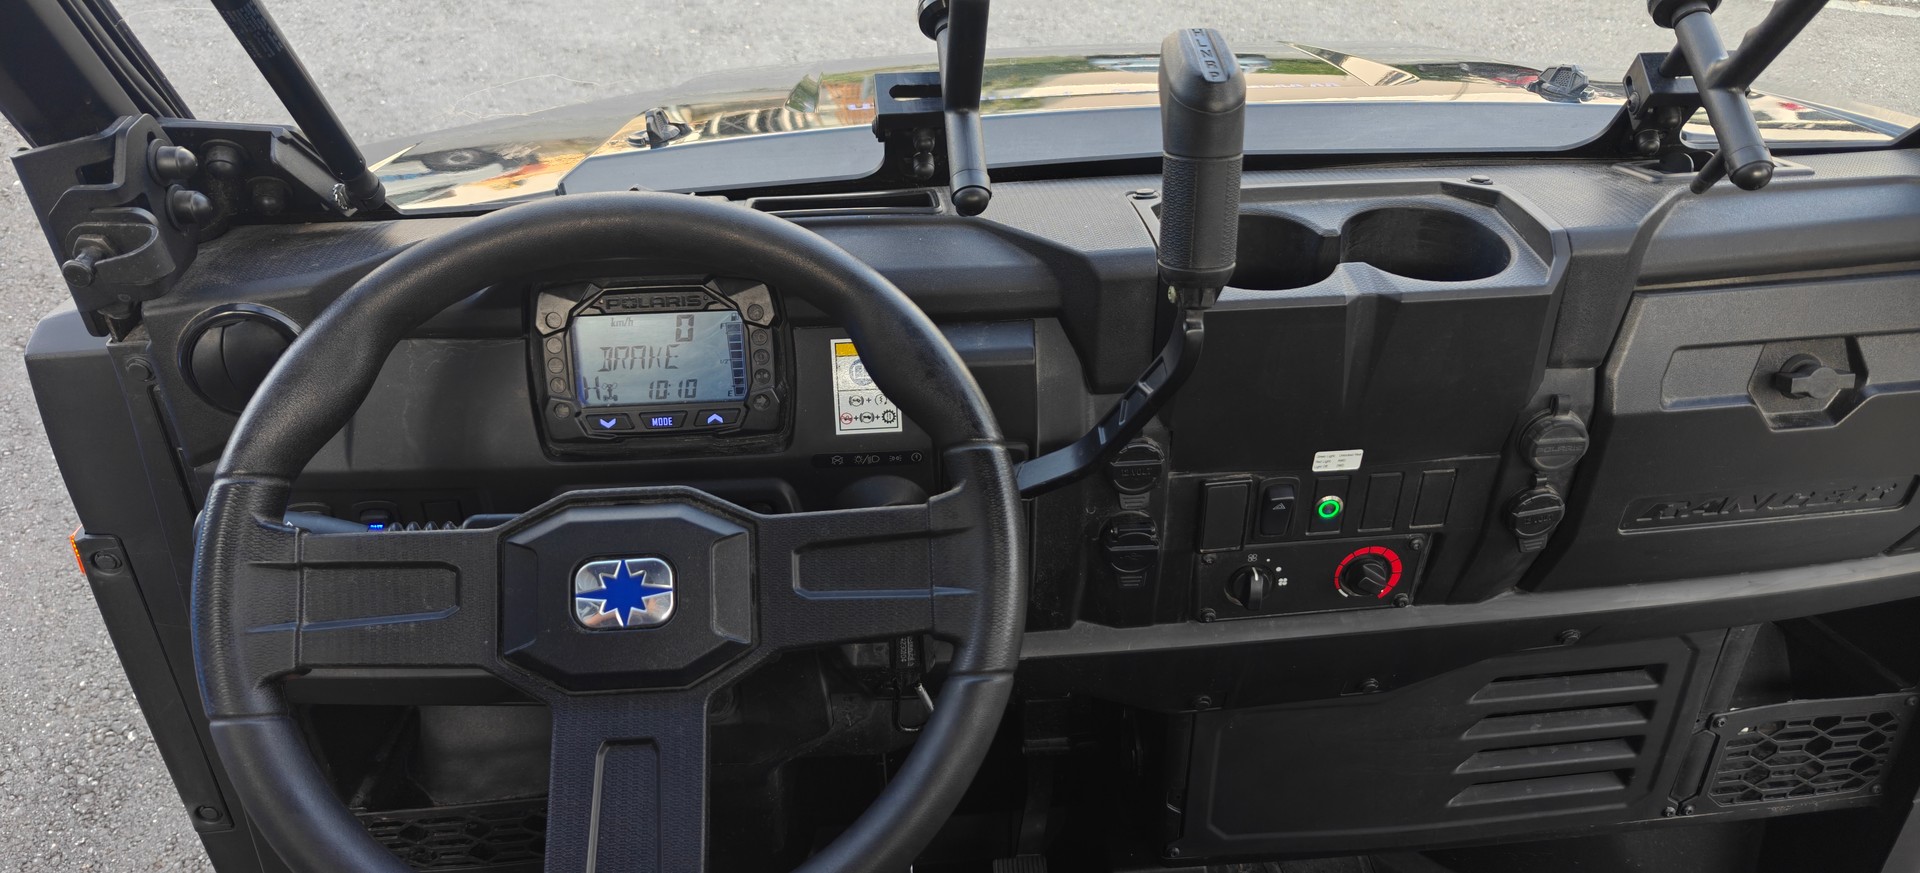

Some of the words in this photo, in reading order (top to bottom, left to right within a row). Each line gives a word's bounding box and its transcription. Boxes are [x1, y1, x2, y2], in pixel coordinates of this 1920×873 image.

[605, 295, 702, 310] POLARIS
[610, 316, 634, 328] km/h
[675, 314, 695, 343] 0
[597, 344, 681, 373] BRAKE
[583, 376, 601, 401] H
[649, 378, 698, 400] 10:10
[651, 416, 673, 427] MODE
[1535, 444, 1584, 455] POLARIS
[1635, 483, 1897, 521] RANGER
